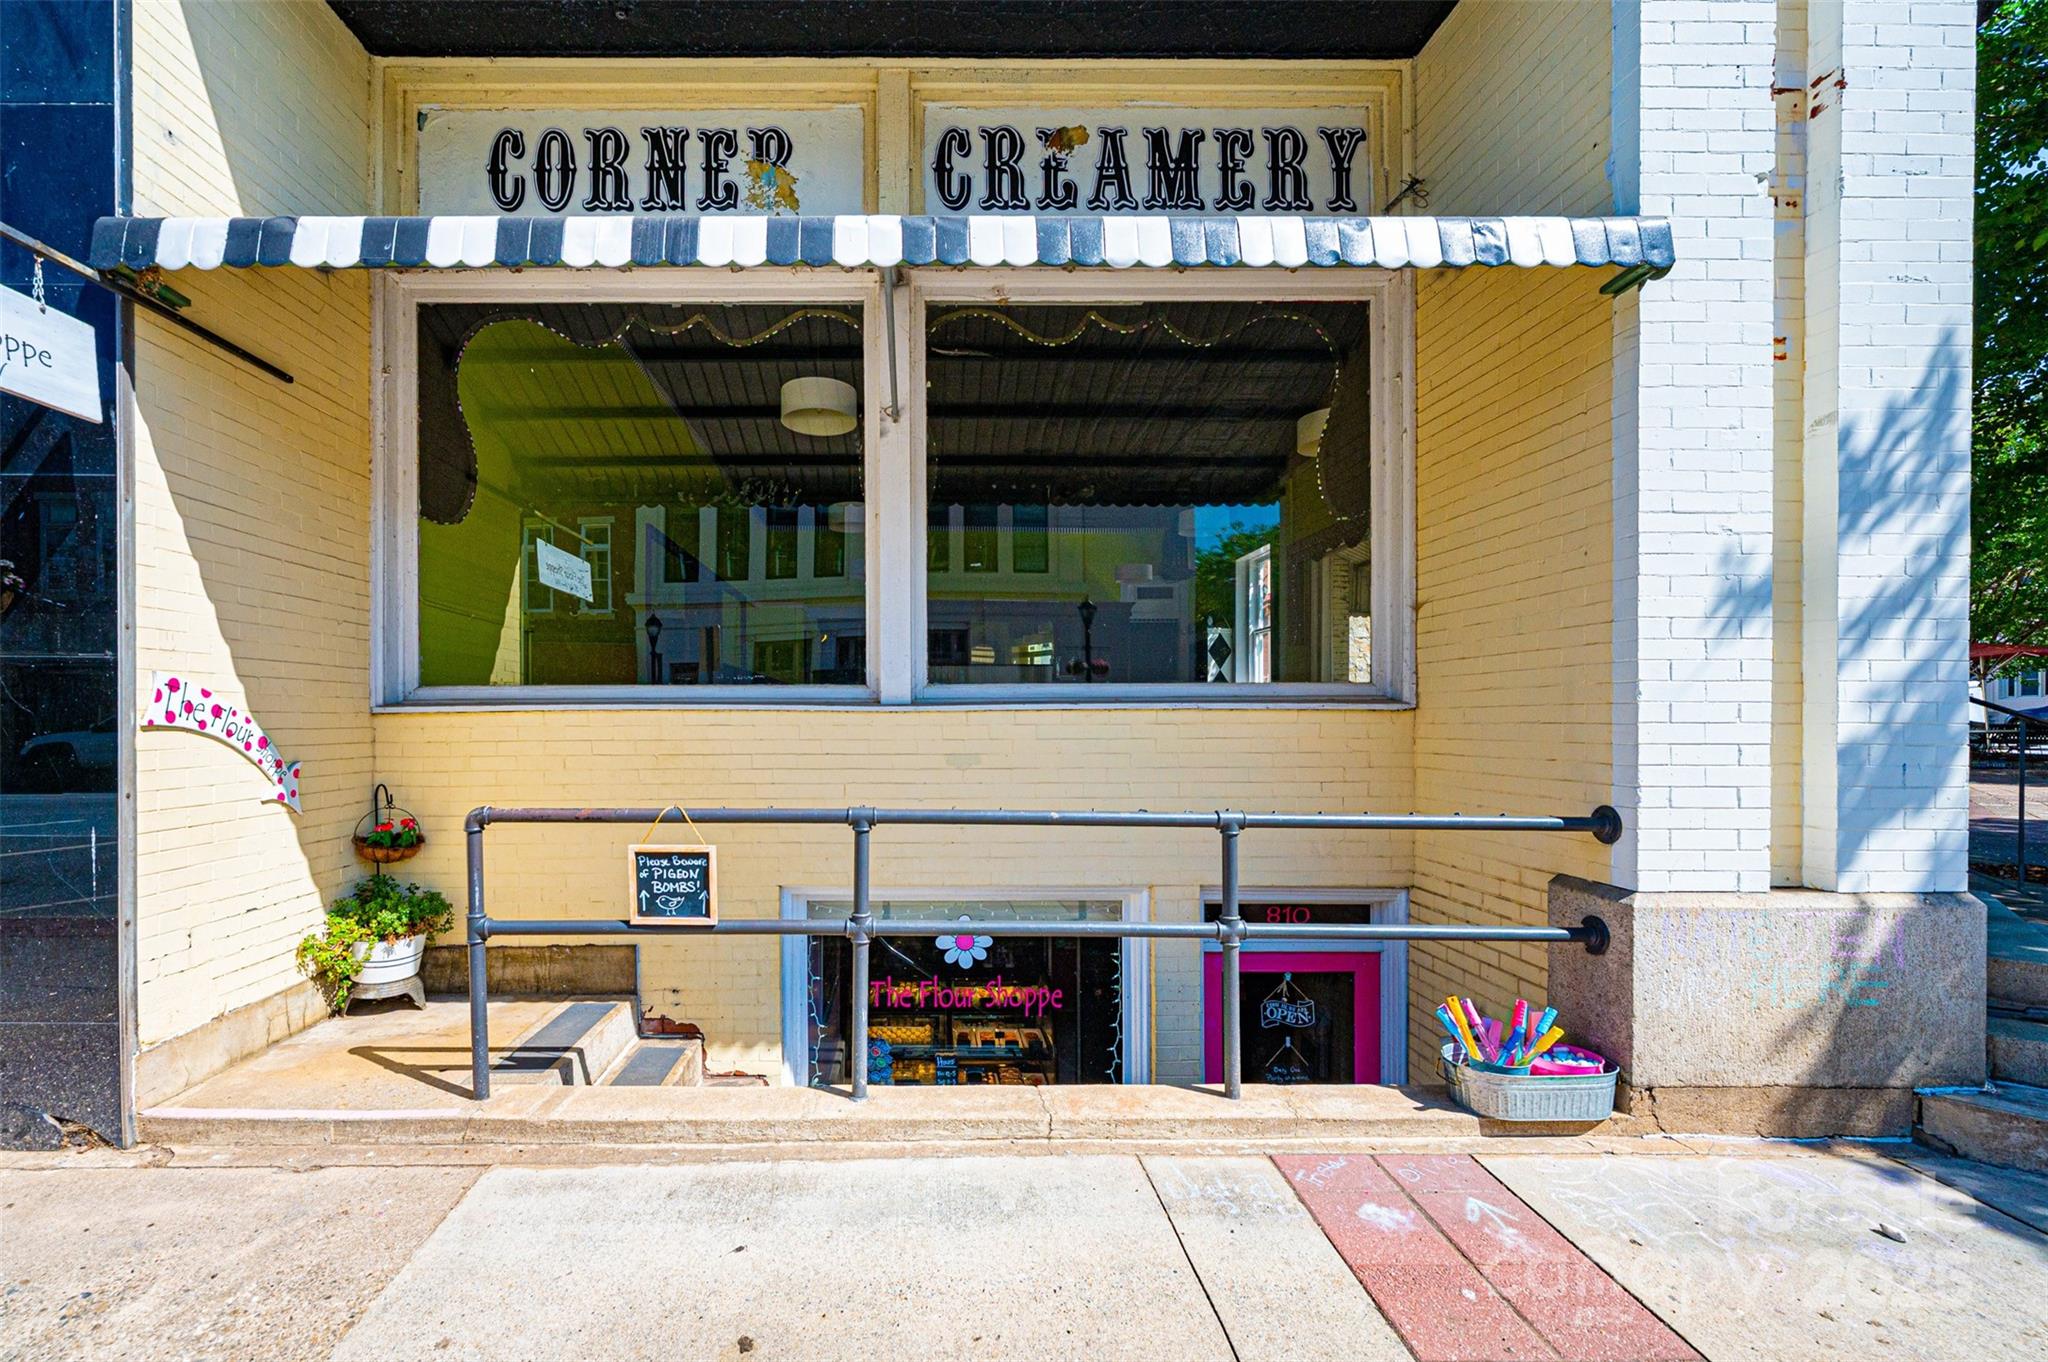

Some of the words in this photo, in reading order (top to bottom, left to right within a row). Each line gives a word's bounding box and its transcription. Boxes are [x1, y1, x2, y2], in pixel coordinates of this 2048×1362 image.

[932, 125, 1367, 211] CREAMERY
[0, 334, 52, 367] ppe
[164, 681, 205, 724] The
[211, 706, 253, 743] Flour
[637, 855, 671, 867] Please
[639, 868, 649, 878] of
[651, 867, 700, 879] PIGEON
[651, 880, 700, 893] BOMBS!
[1266, 906, 1311, 923] 810
[870, 975, 911, 1008] The
[919, 975, 974, 1008] Flour
[985, 975, 1063, 1018] Shoppe
[1266, 1007, 1309, 1024] OPEN
